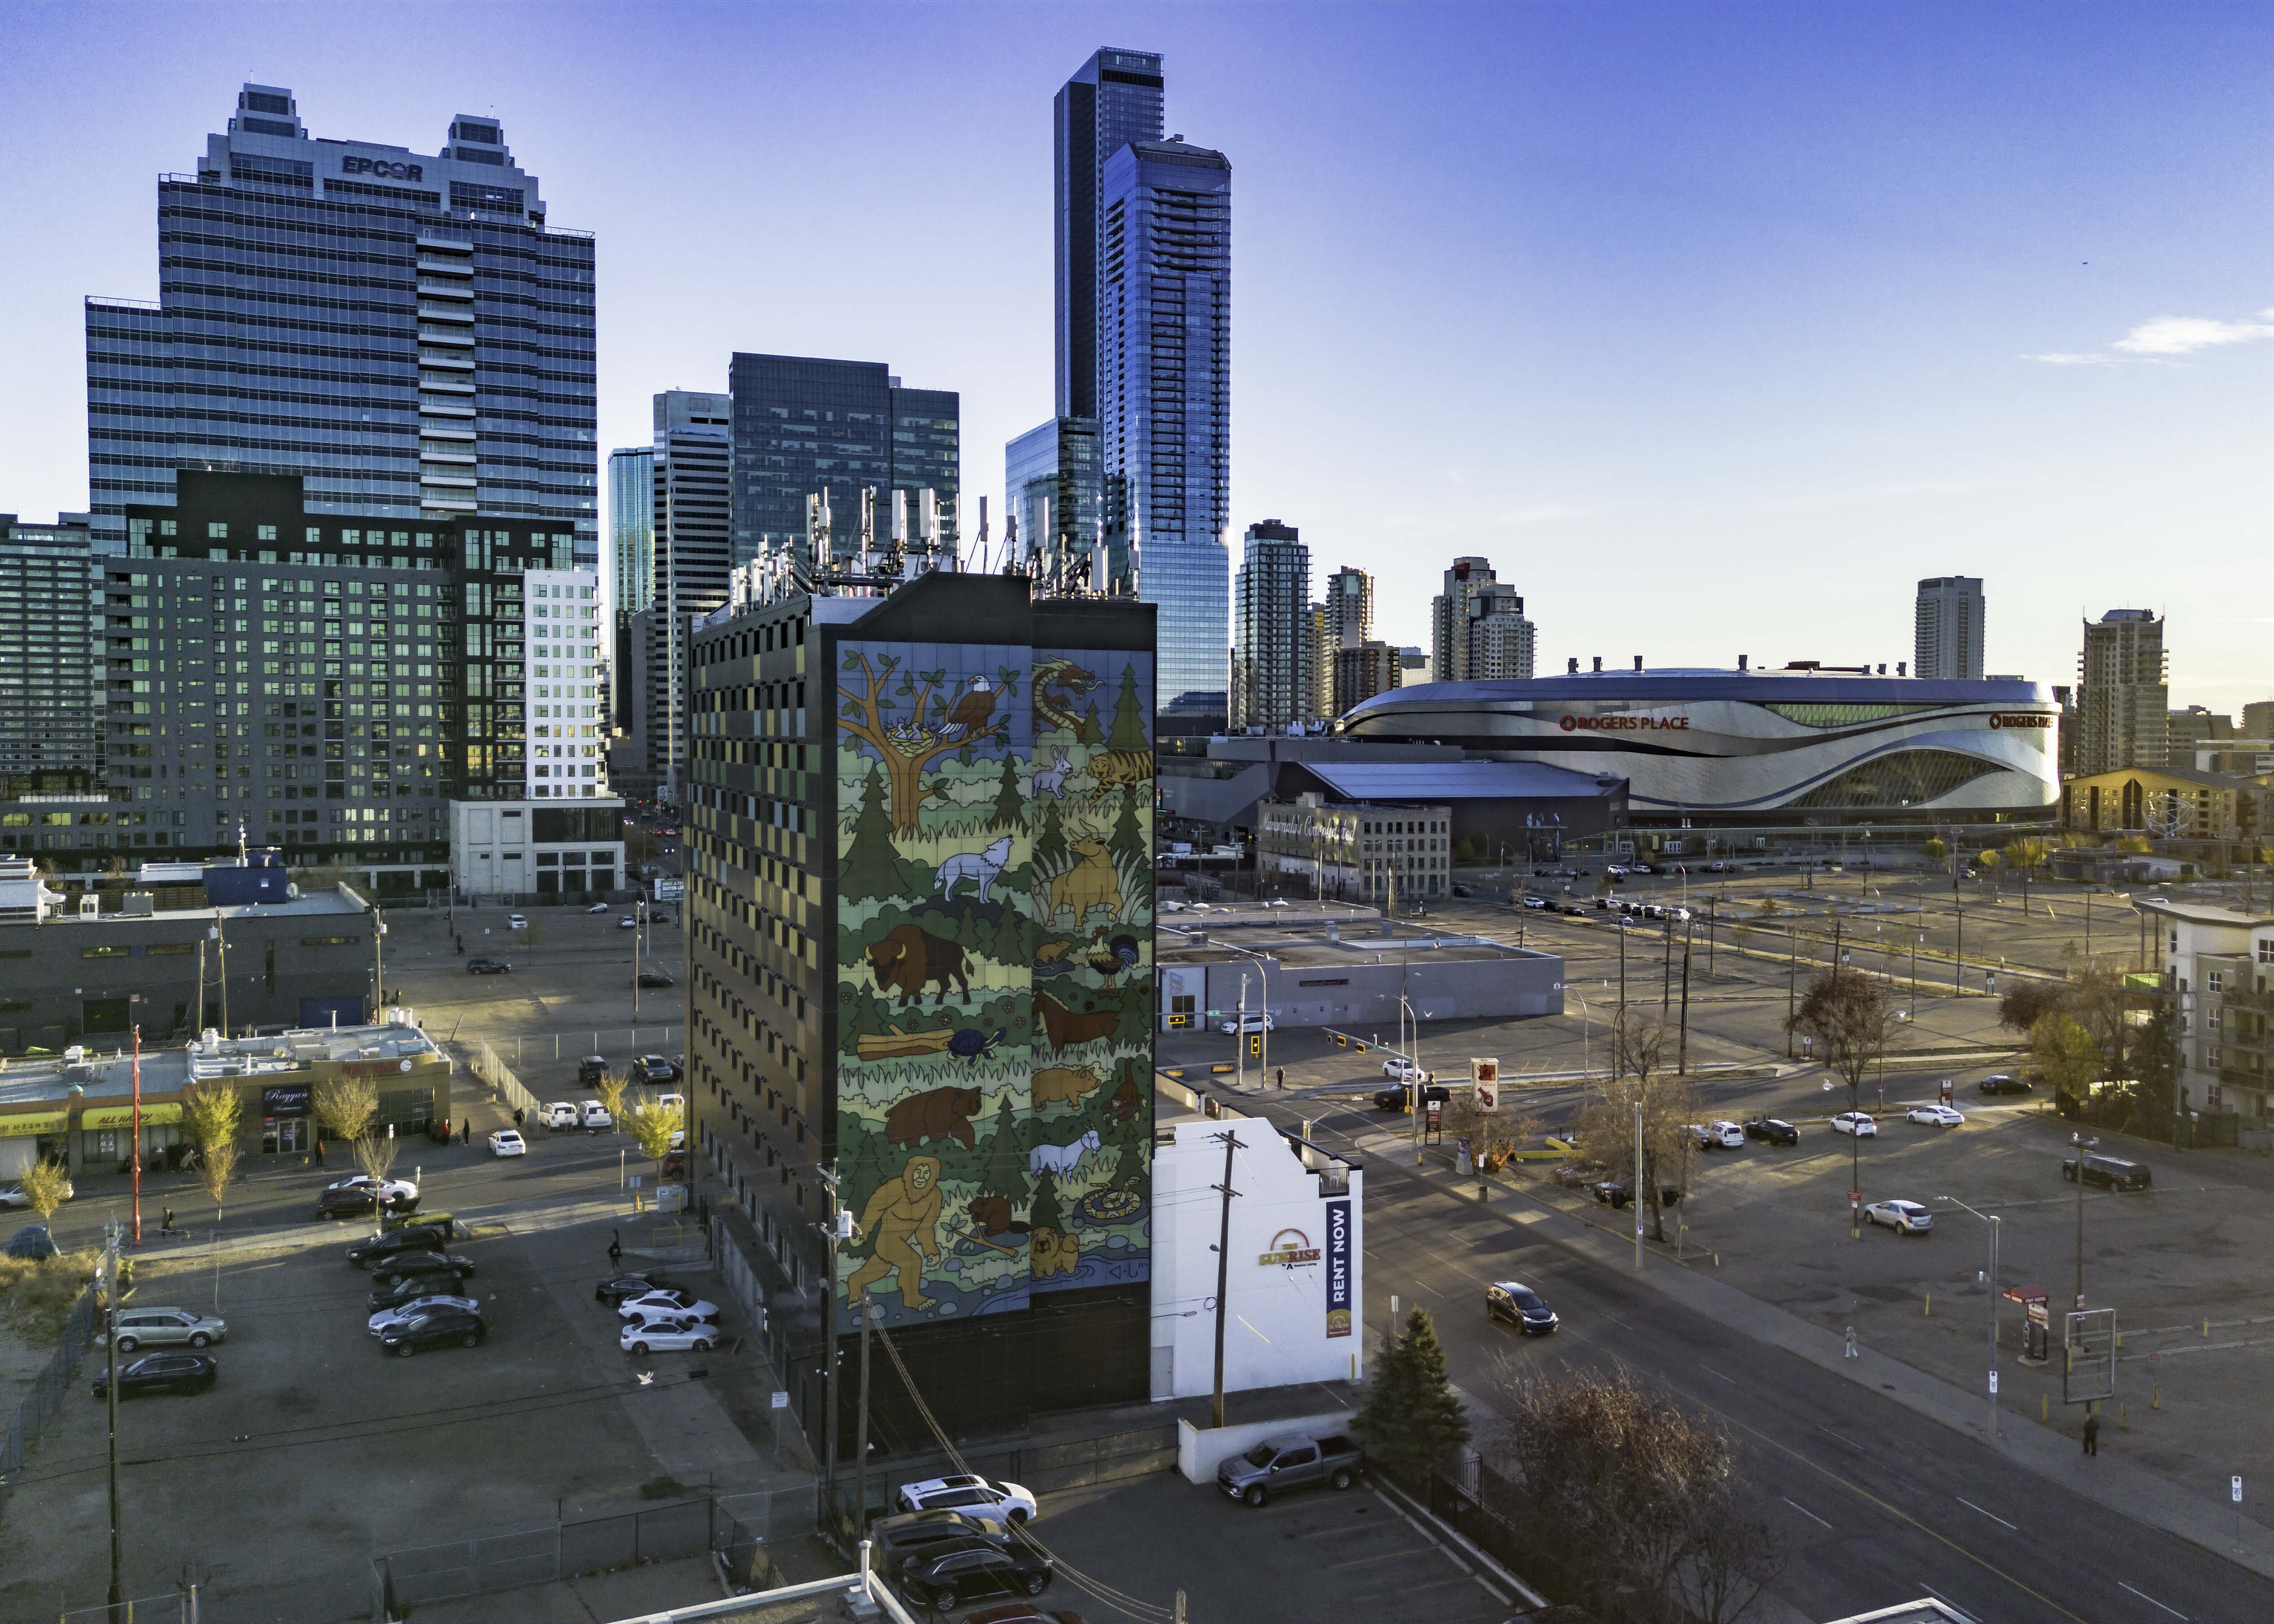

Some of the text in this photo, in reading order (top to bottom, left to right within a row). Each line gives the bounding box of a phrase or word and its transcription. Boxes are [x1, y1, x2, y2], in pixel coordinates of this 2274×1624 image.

[343, 156, 422, 182] EPCOR
[1578, 717, 1689, 729] ROGERS PLACE
[265, 1089, 309, 1103] Rayyan
[119, 1114, 152, 1122] HAPY
[1259, 1249, 1321, 1266] SUNRISE
[1334, 1209, 1344, 1302] RENT NOW
